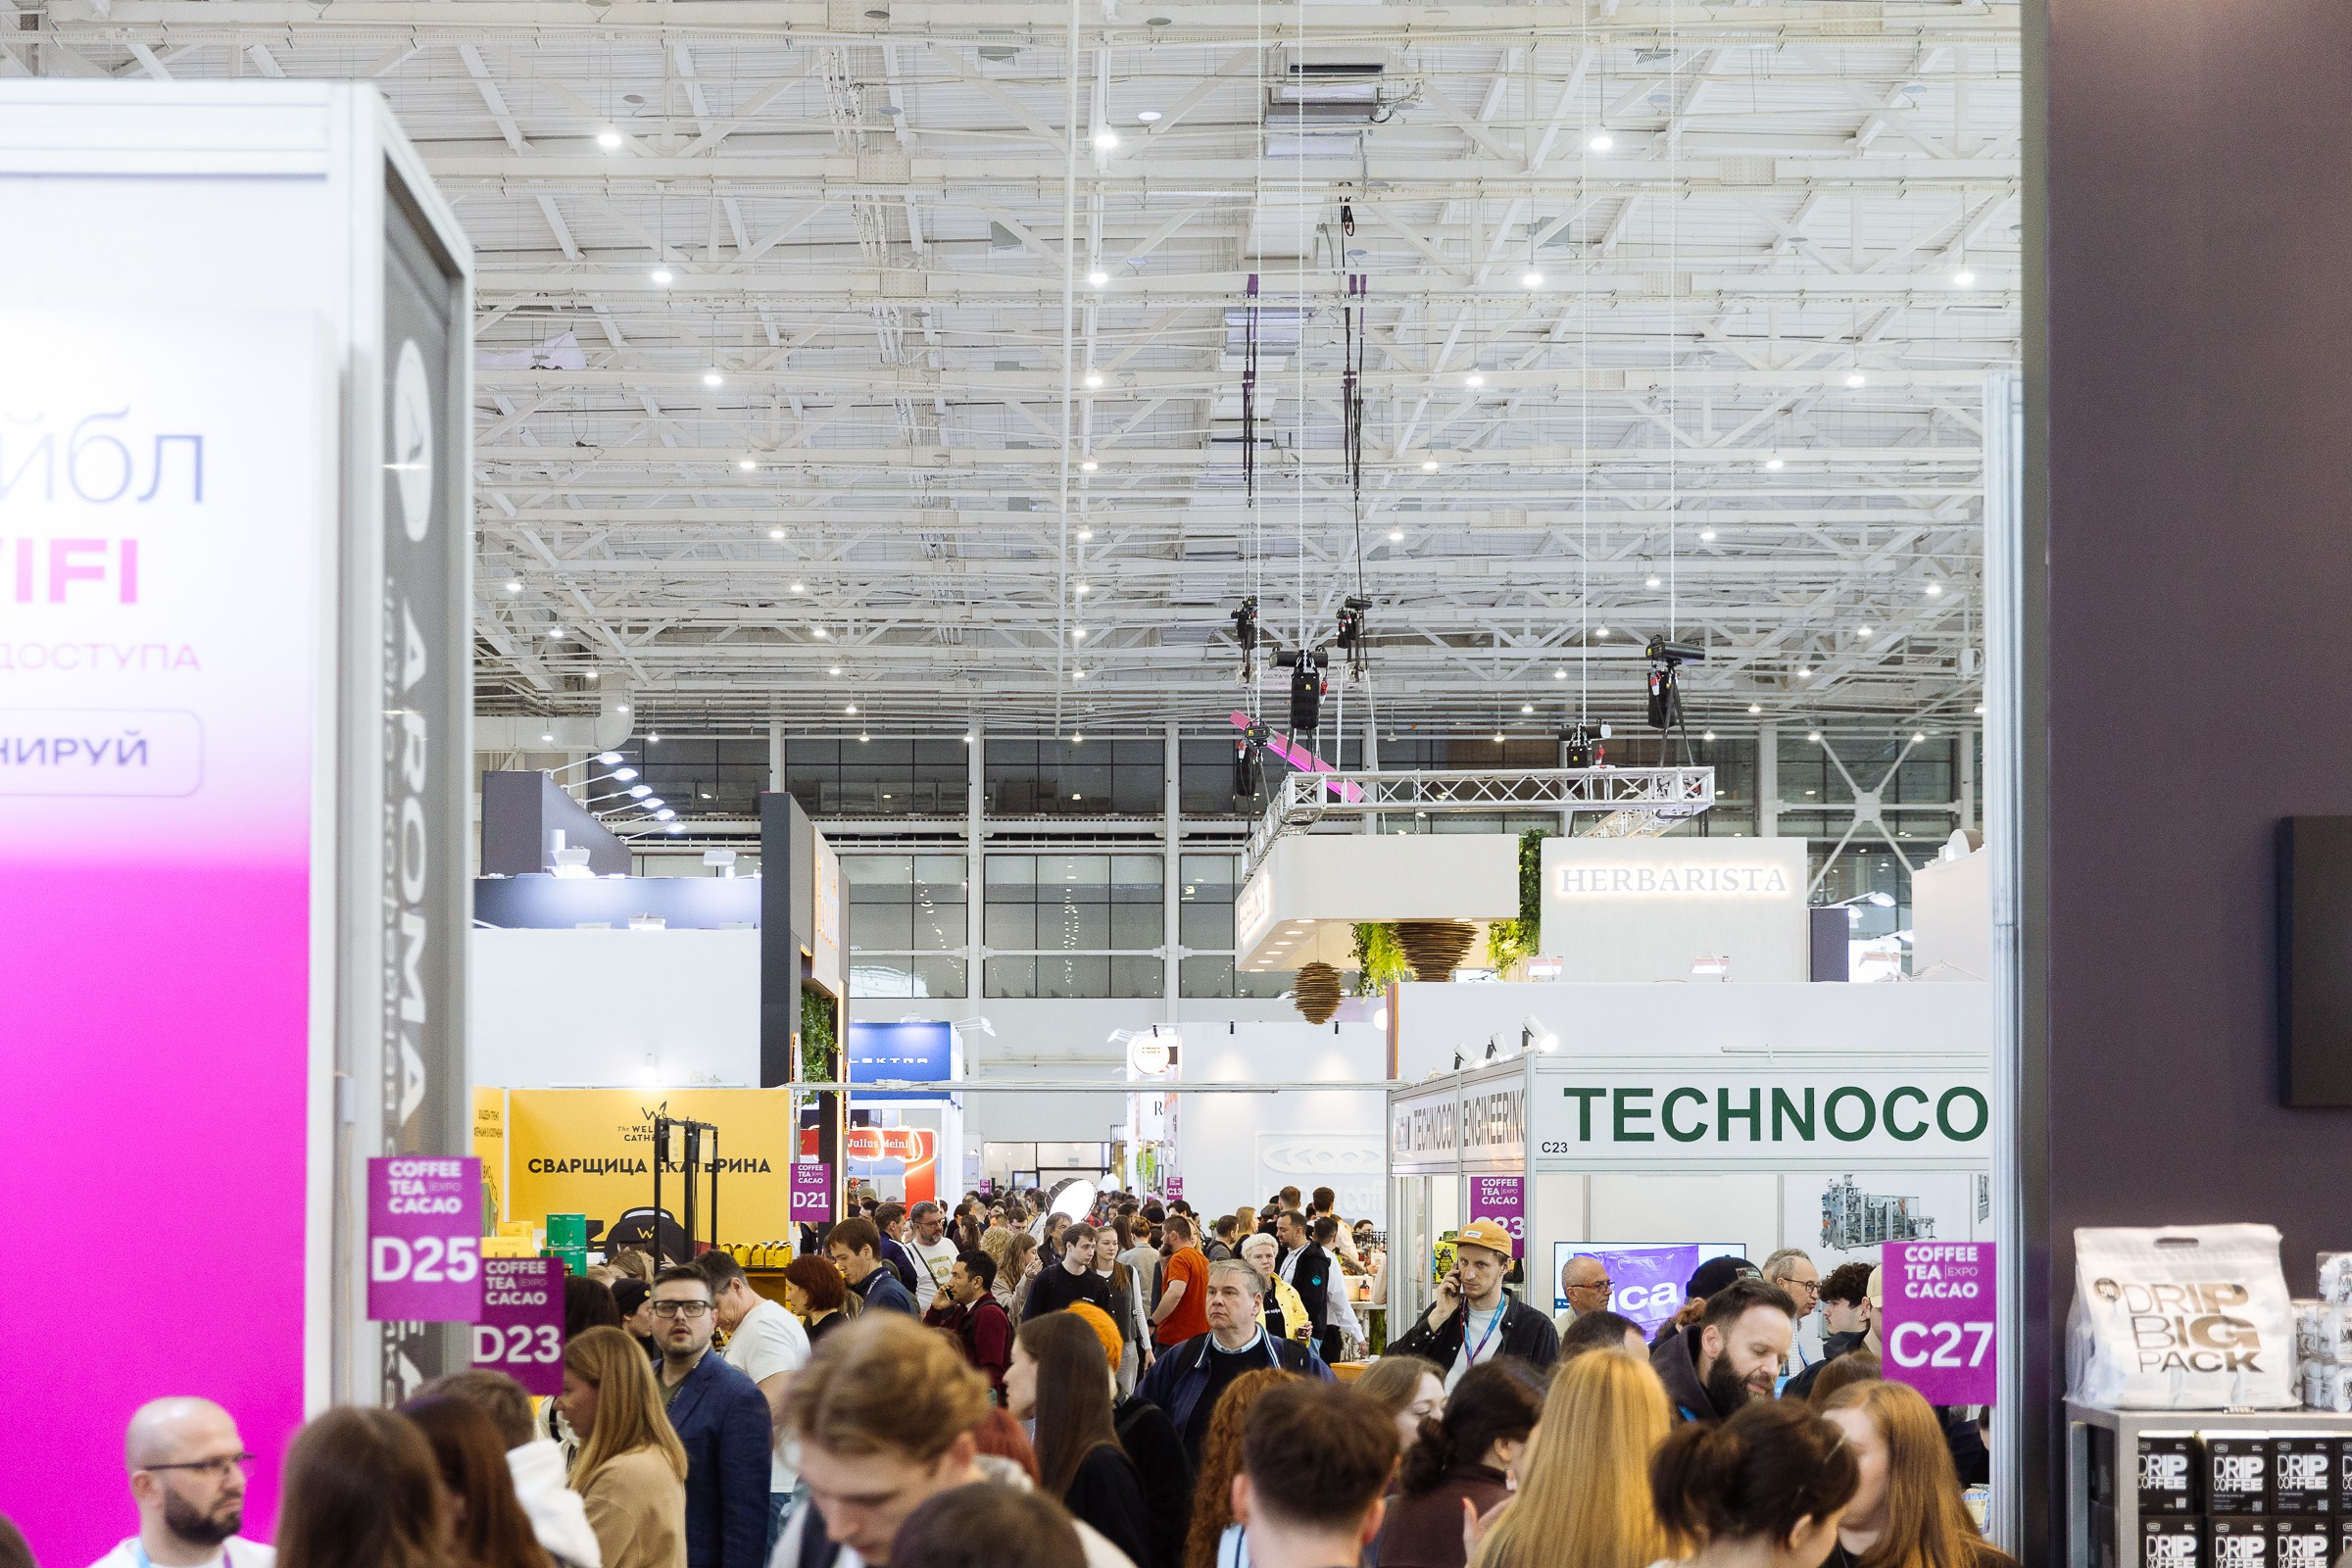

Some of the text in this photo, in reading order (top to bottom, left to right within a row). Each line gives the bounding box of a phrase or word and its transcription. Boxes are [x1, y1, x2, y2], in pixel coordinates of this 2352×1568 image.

[0, 538, 138, 604] IFI
[400, 597, 427, 1129] AROMA
[1561, 868, 1787, 892] HERBARISTA
[1563, 1086, 1988, 1143] TECHNOCO
[848, 1138, 879, 1149] Julius
[1541, 1141, 1568, 1154] C23
[388, 1161, 462, 1178] COFFEE
[528, 1157, 771, 1176] СВАРЩИЦА КЕРИНА
[388, 1179, 462, 1196] TEA EXPO
[387, 1197, 462, 1214] CACAO
[792, 1192, 829, 1208] D21
[1474, 1216, 1525, 1240] 23
[373, 1236, 478, 1282] D25
[1904, 1247, 1978, 1262] COFFEE
[485, 1261, 547, 1274] COFFEE
[1904, 1264, 1978, 1280] TEA EXPO
[485, 1277, 547, 1290] TEA EXPO
[1904, 1282, 1979, 1298] CACAO
[485, 1292, 548, 1305] CACAO
[2122, 1283, 2249, 1314] DRIP
[2131, 1314, 2262, 1349] BIG
[472, 1325, 562, 1363] D23
[1889, 1321, 1994, 1368] C27
[2138, 1350, 2265, 1373] PACK
[2137, 1454, 2188, 1477] DRIP
[2214, 1456, 2264, 1479] DRIP
[2278, 1454, 2328, 1477] DRIP
[2214, 1478, 2264, 1492] COFFEE
[2278, 1476, 2328, 1490] COFFEE
[2146, 1535, 2197, 1557] DRIP
[2215, 1536, 2266, 1558] DRIP
[2278, 1535, 2328, 1557] DRIP
